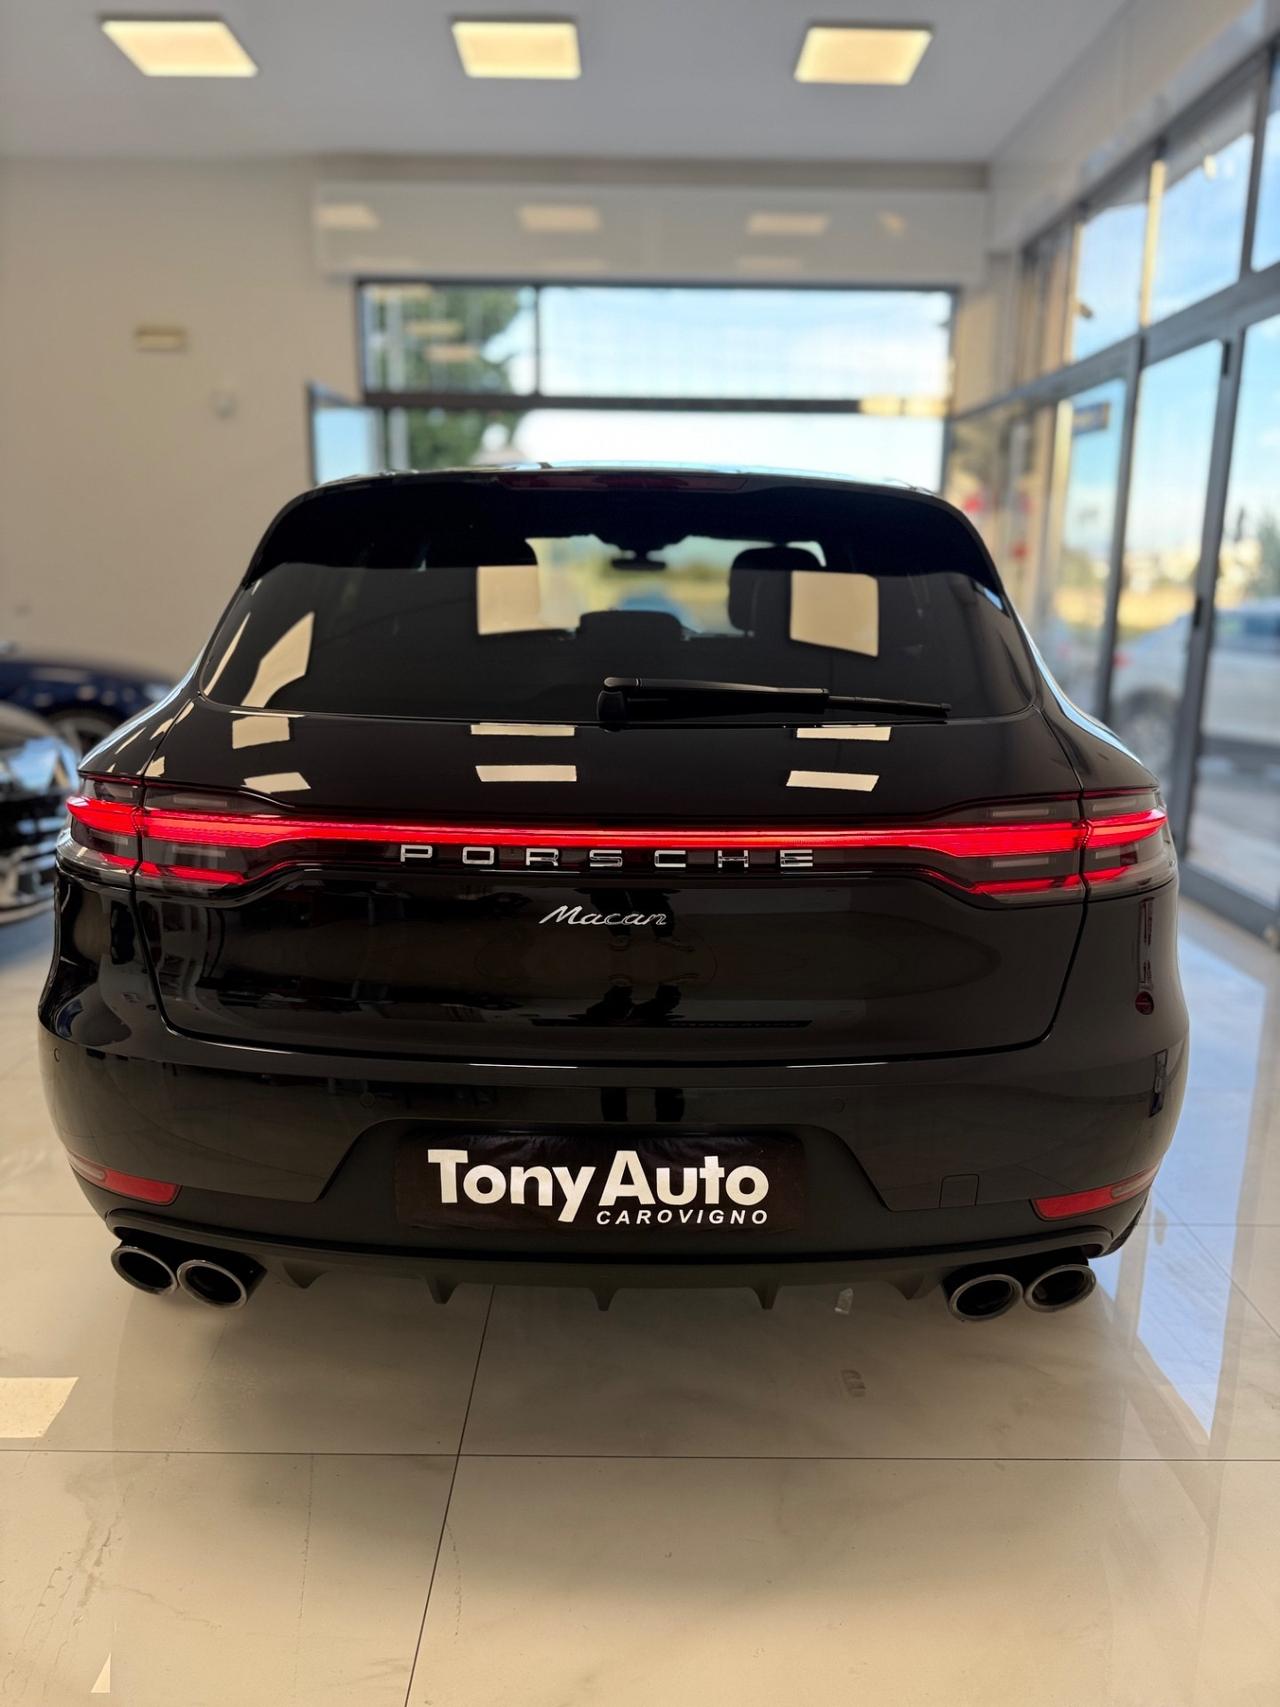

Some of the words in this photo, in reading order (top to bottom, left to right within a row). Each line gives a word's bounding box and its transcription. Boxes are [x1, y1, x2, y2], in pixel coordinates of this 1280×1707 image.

[400, 844, 814, 868] PORSCHE
[538, 904, 667, 926] Macan
[427, 1149, 596, 1223] Tony
[598, 1150, 769, 1207] Auto
[596, 1209, 769, 1225] CAROVIGNO
